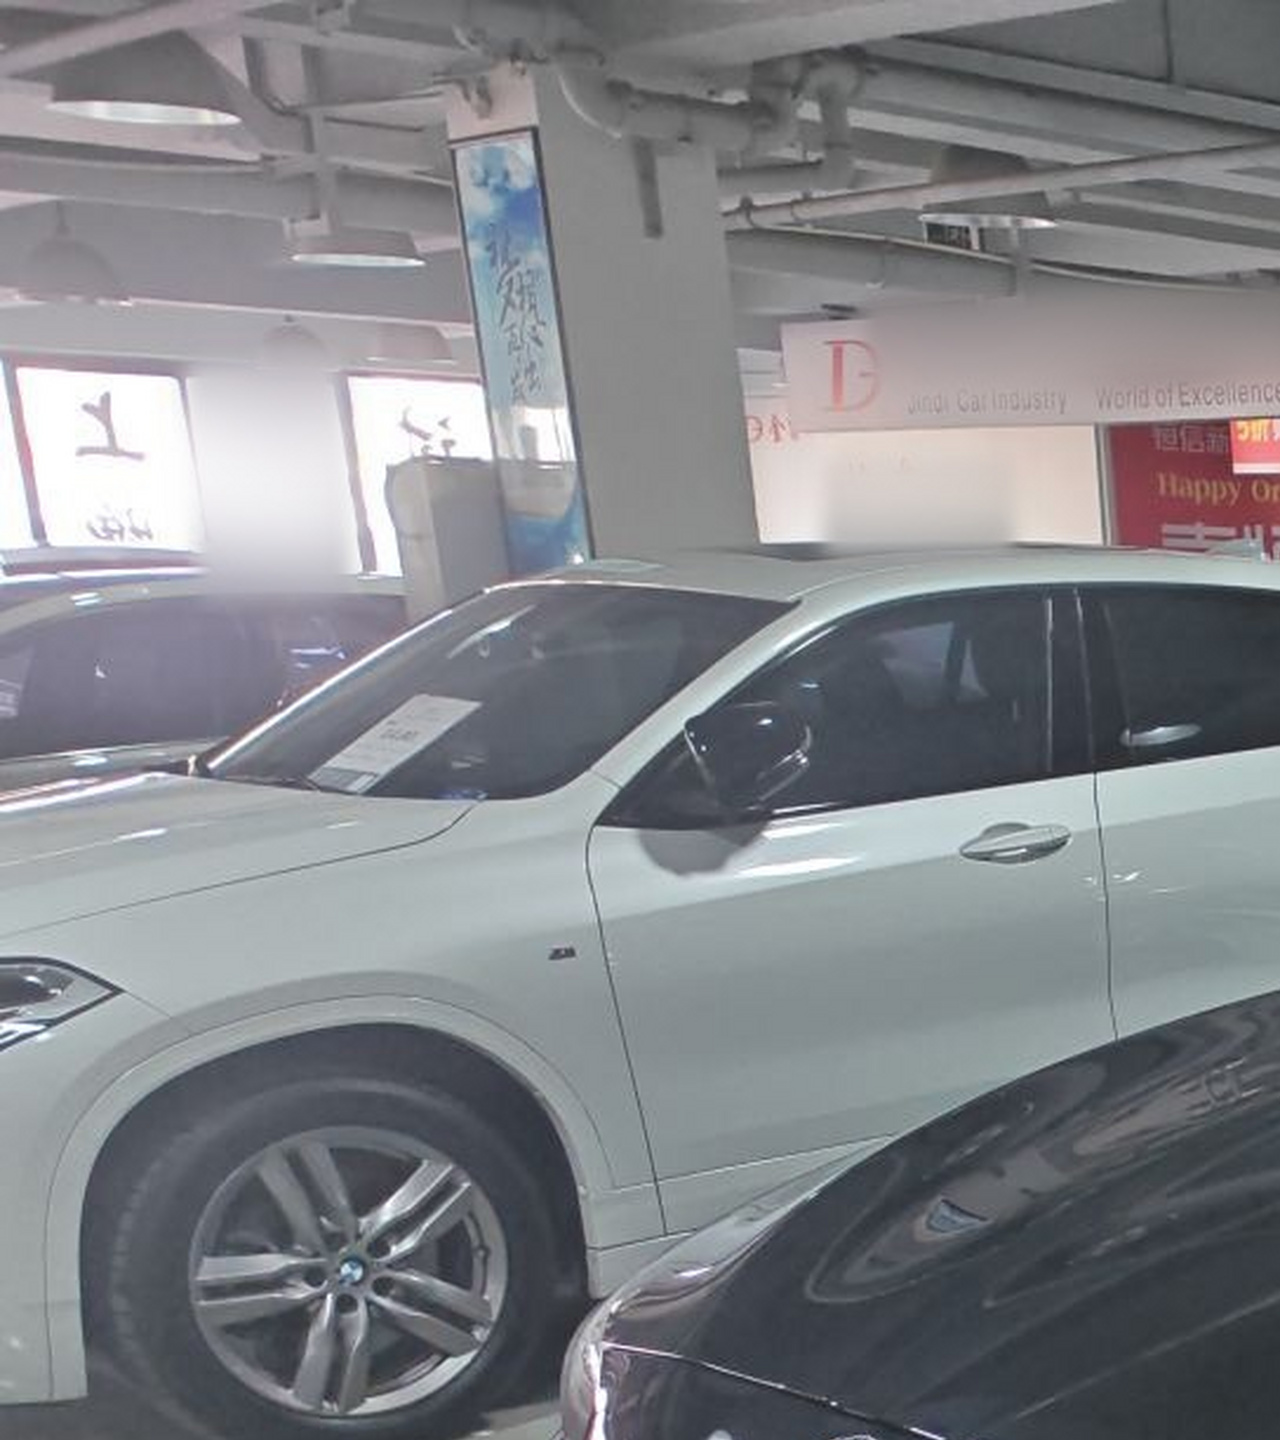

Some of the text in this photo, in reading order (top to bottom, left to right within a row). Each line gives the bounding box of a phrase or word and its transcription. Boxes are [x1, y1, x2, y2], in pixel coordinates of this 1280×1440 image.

[1095, 385, 1150, 410] World
[1154, 381, 1174, 408] of
[1157, 471, 1241, 507] Happy
